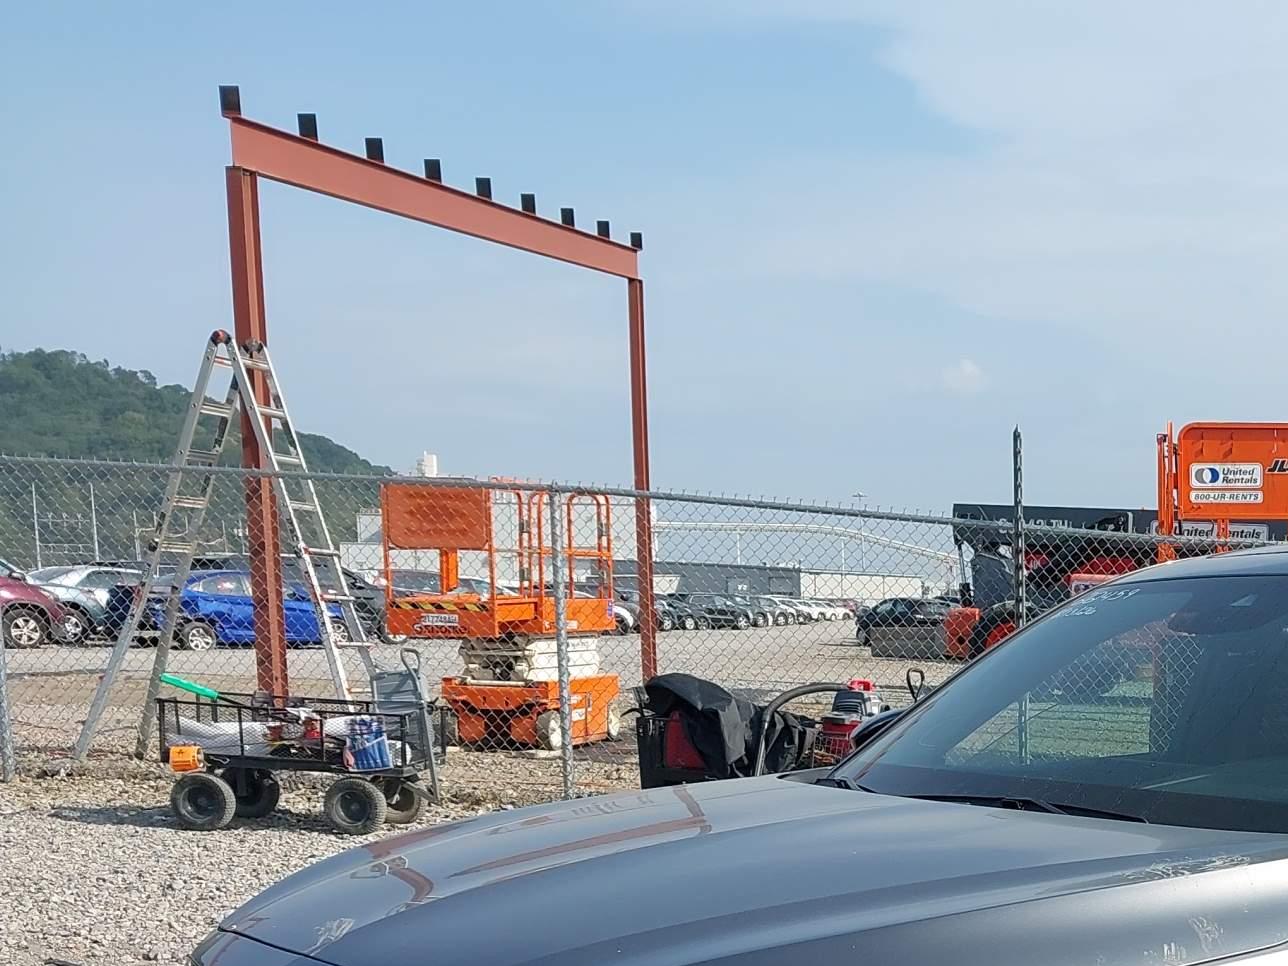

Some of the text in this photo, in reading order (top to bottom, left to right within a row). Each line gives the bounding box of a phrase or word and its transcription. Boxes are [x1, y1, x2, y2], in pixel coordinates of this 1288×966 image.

[1222, 467, 1254, 476] United
[1222, 476, 1258, 485] Rentals
[1194, 493, 1259, 501] 800-UR-RENTS
